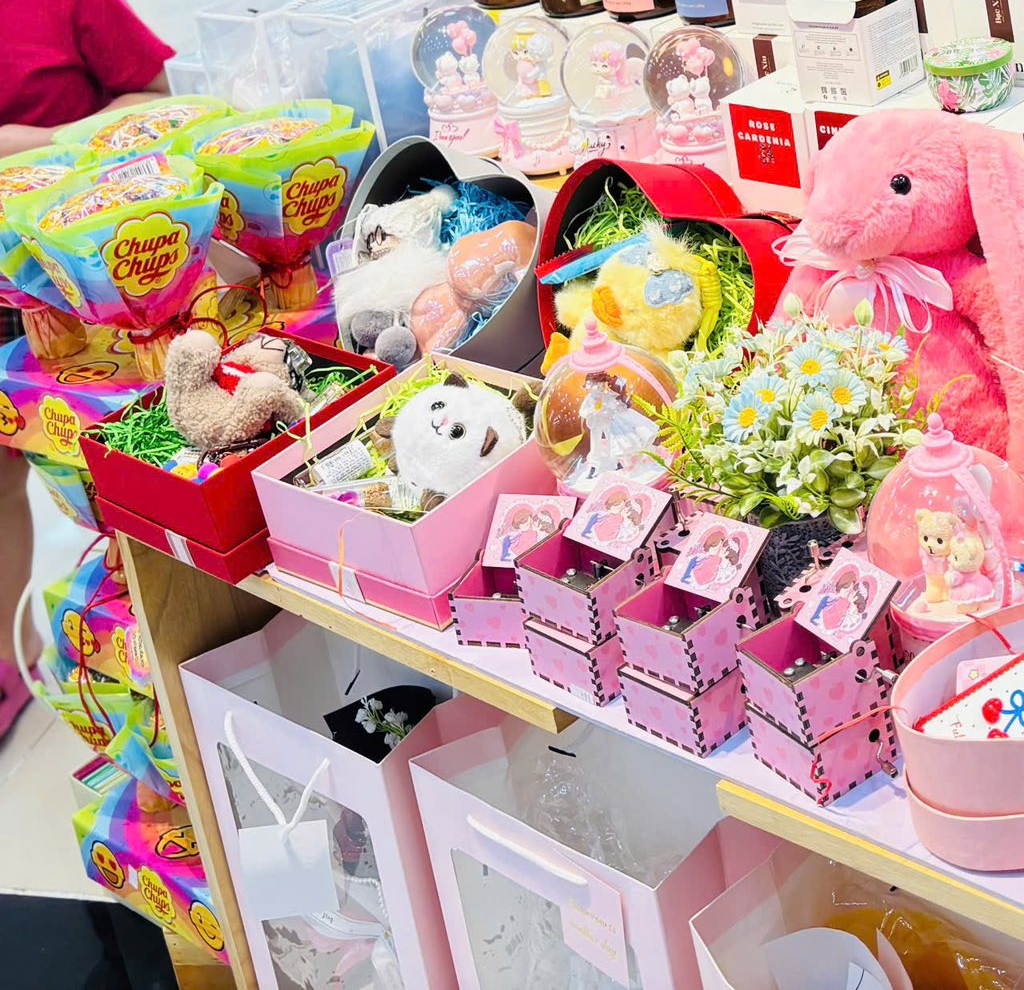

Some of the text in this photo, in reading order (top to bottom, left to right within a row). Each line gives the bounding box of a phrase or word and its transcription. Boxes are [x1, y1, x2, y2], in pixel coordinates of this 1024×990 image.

[749, 119, 776, 132] ROSE
[737, 131, 792, 147] GARDENIA
[286, 174, 340, 200] Chupa
[283, 191, 337, 226] Chups
[114, 230, 181, 259] Chupa
[113, 248, 179, 286] Chups
[44, 407, 76, 426] Chupa
[46, 421, 78, 447] Chup
[142, 875, 168, 898] Chupa
